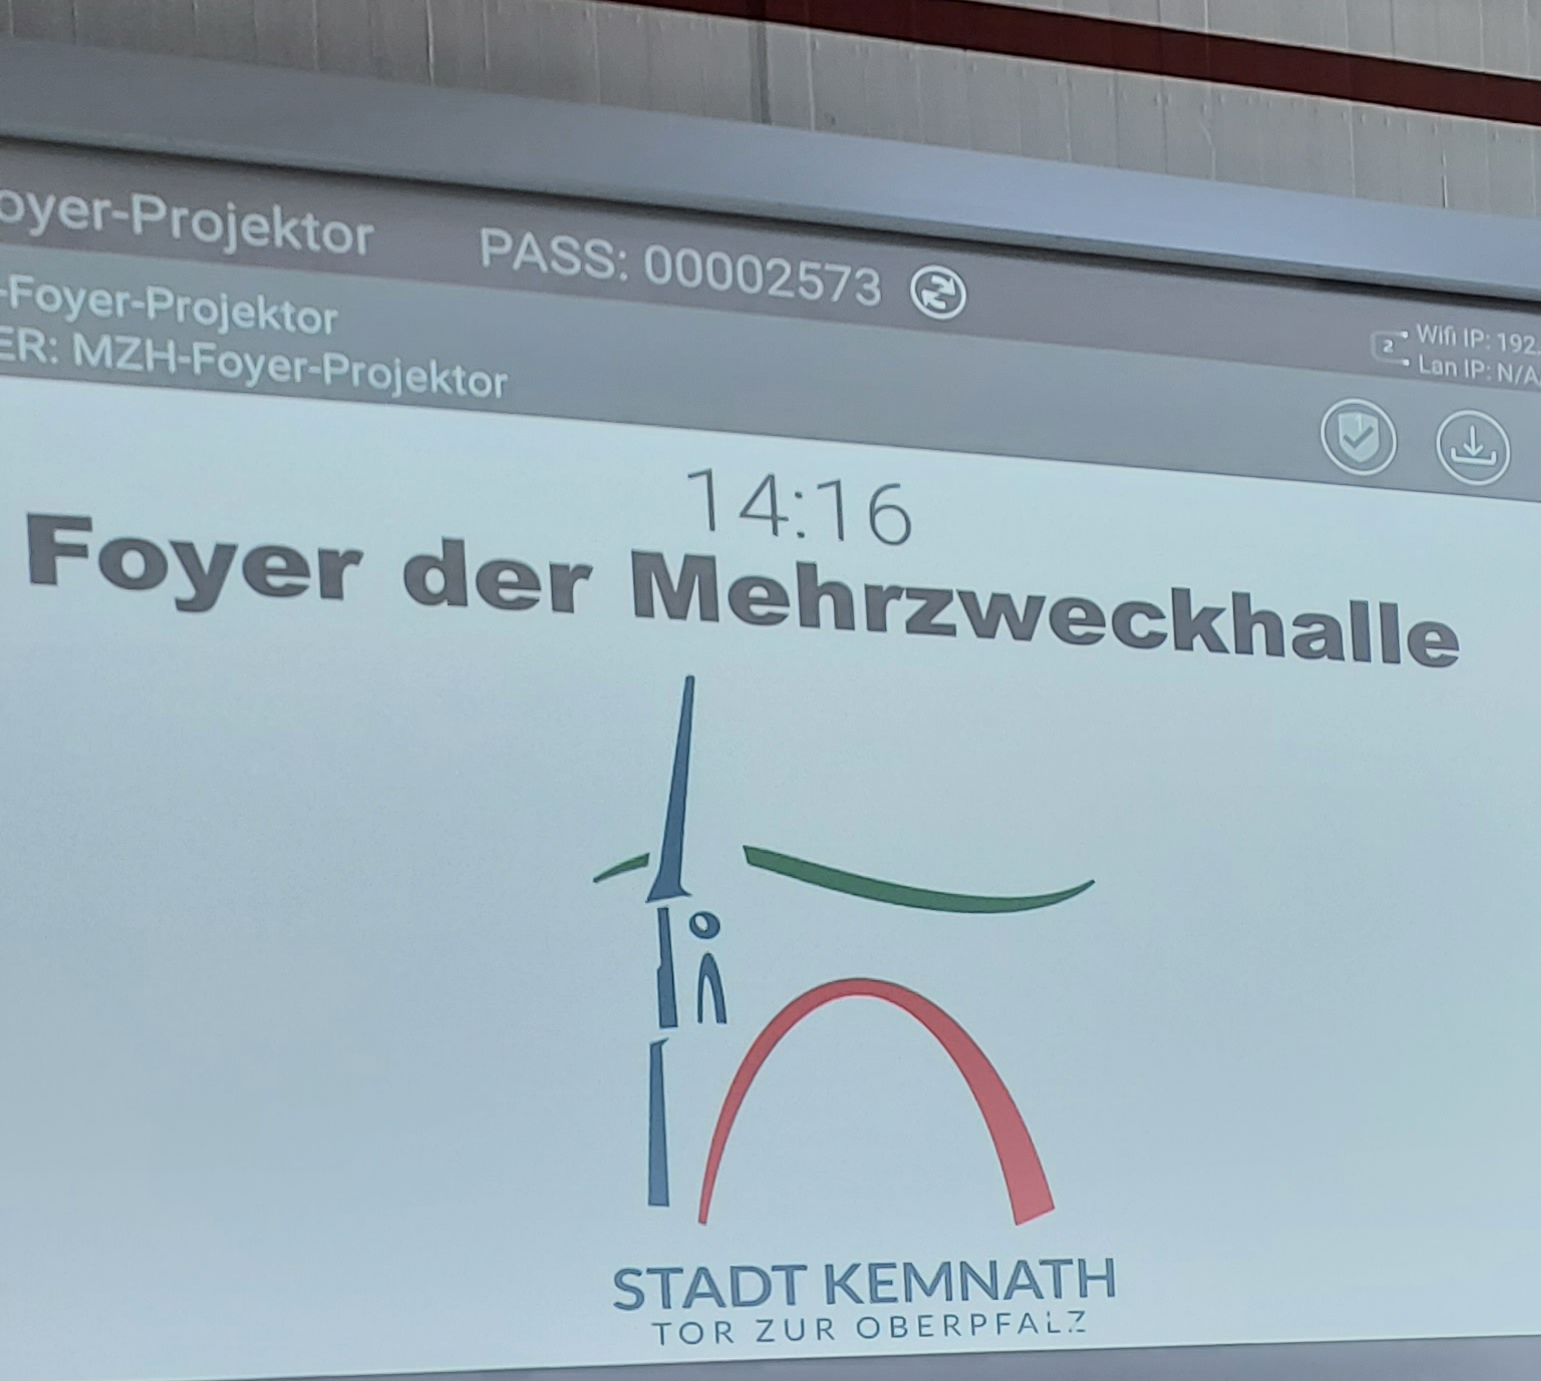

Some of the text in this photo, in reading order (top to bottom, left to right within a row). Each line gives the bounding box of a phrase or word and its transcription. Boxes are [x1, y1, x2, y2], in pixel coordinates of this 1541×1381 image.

[0, 188, 375, 256] oyer-Projektor
[480, 227, 883, 308] PASS: 00002573
[0, 325, 509, 401] ER: MZH-Foyer-Projektor
[1416, 323, 1457, 346] Wifi
[1463, 327, 1491, 350] IP:
[1419, 353, 1458, 377] Lan
[1464, 358, 1492, 381] IP:
[687, 468, 913, 547] 14:16
[26, 512, 1461, 670] Foyer der Mehrzweckhalle
[613, 1257, 1116, 1311] STADT KEMNATH
[651, 1310, 1087, 1346] TOR ZUR OBERPFALZ
